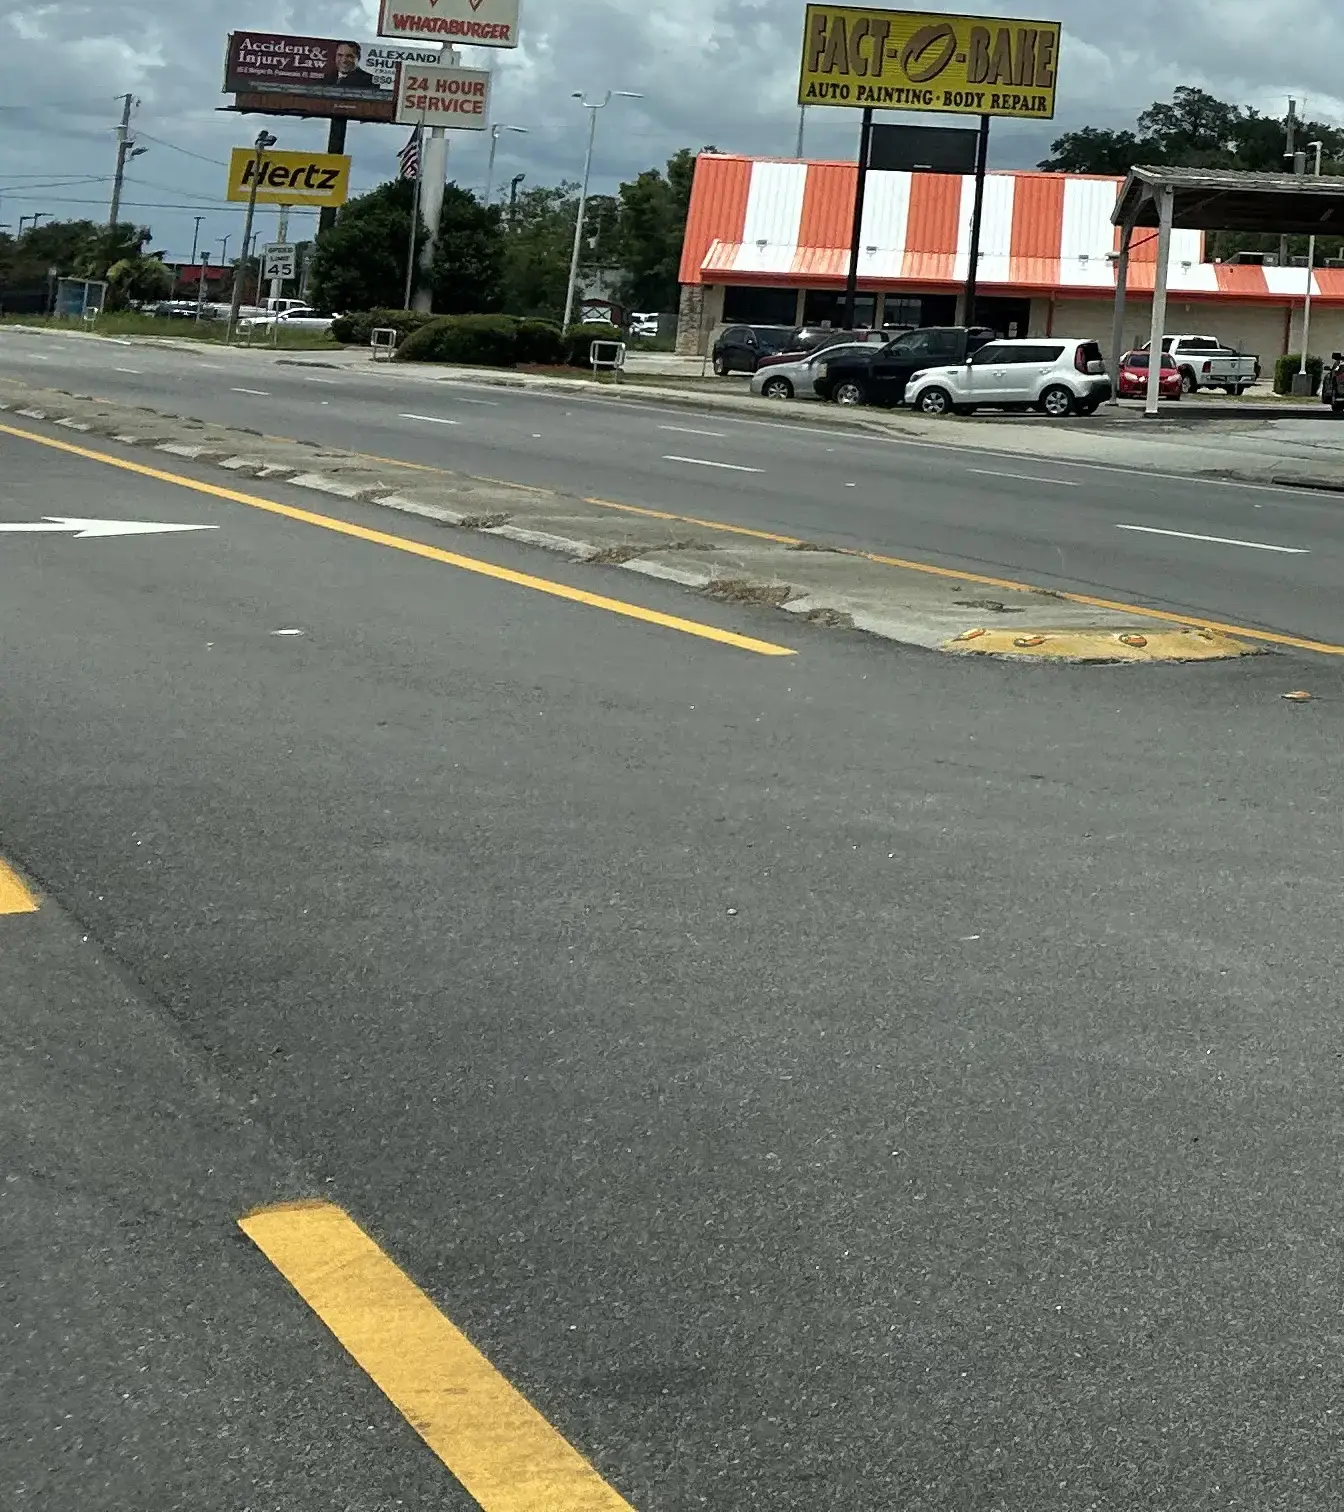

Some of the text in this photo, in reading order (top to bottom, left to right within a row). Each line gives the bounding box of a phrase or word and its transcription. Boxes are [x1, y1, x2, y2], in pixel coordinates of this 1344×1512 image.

[392, 13, 511, 40] WHATABURGER
[239, 38, 310, 56] Accident
[237, 50, 327, 70] Injury Law
[366, 58, 396, 69] SHU
[407, 76, 429, 92] 24
[435, 78, 485, 97] HOUR
[805, 81, 1048, 112] AUTO PAINTING BODY REPAIR
[404, 94, 483, 115] SERVICE
[241, 159, 341, 190] Hertz
[267, 263, 293, 276] 45
